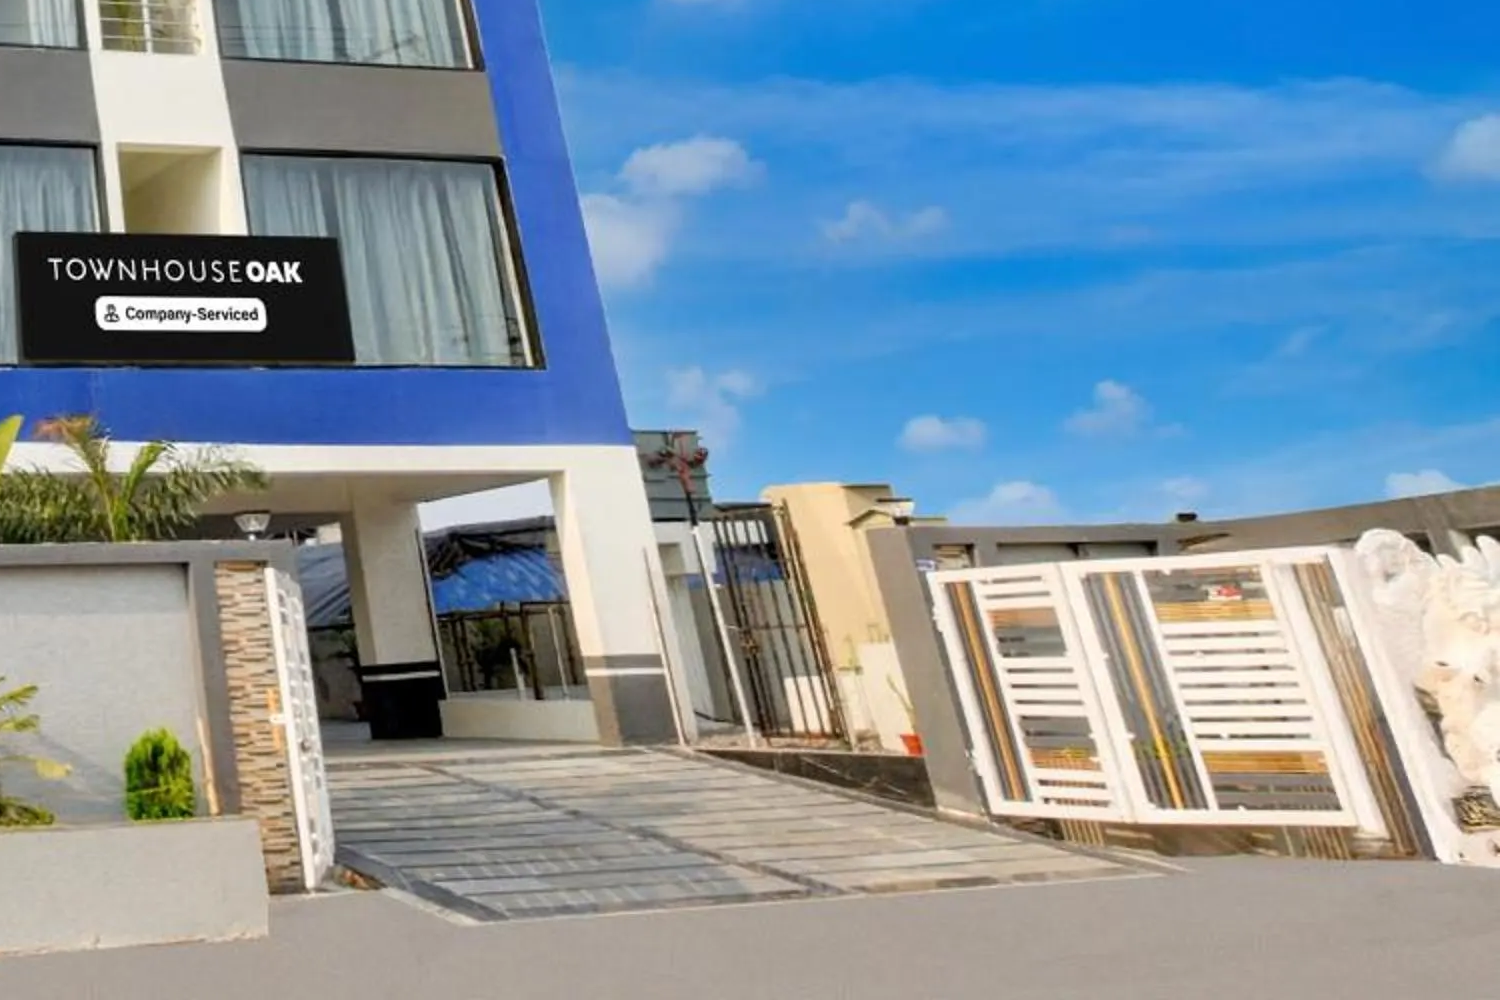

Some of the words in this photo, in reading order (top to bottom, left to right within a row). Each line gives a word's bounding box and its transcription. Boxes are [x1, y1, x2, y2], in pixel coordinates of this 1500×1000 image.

[48, 258, 242, 282] TOWNHOUSE
[246, 261, 303, 283] OAK
[125, 306, 259, 324] Company-Serviced
